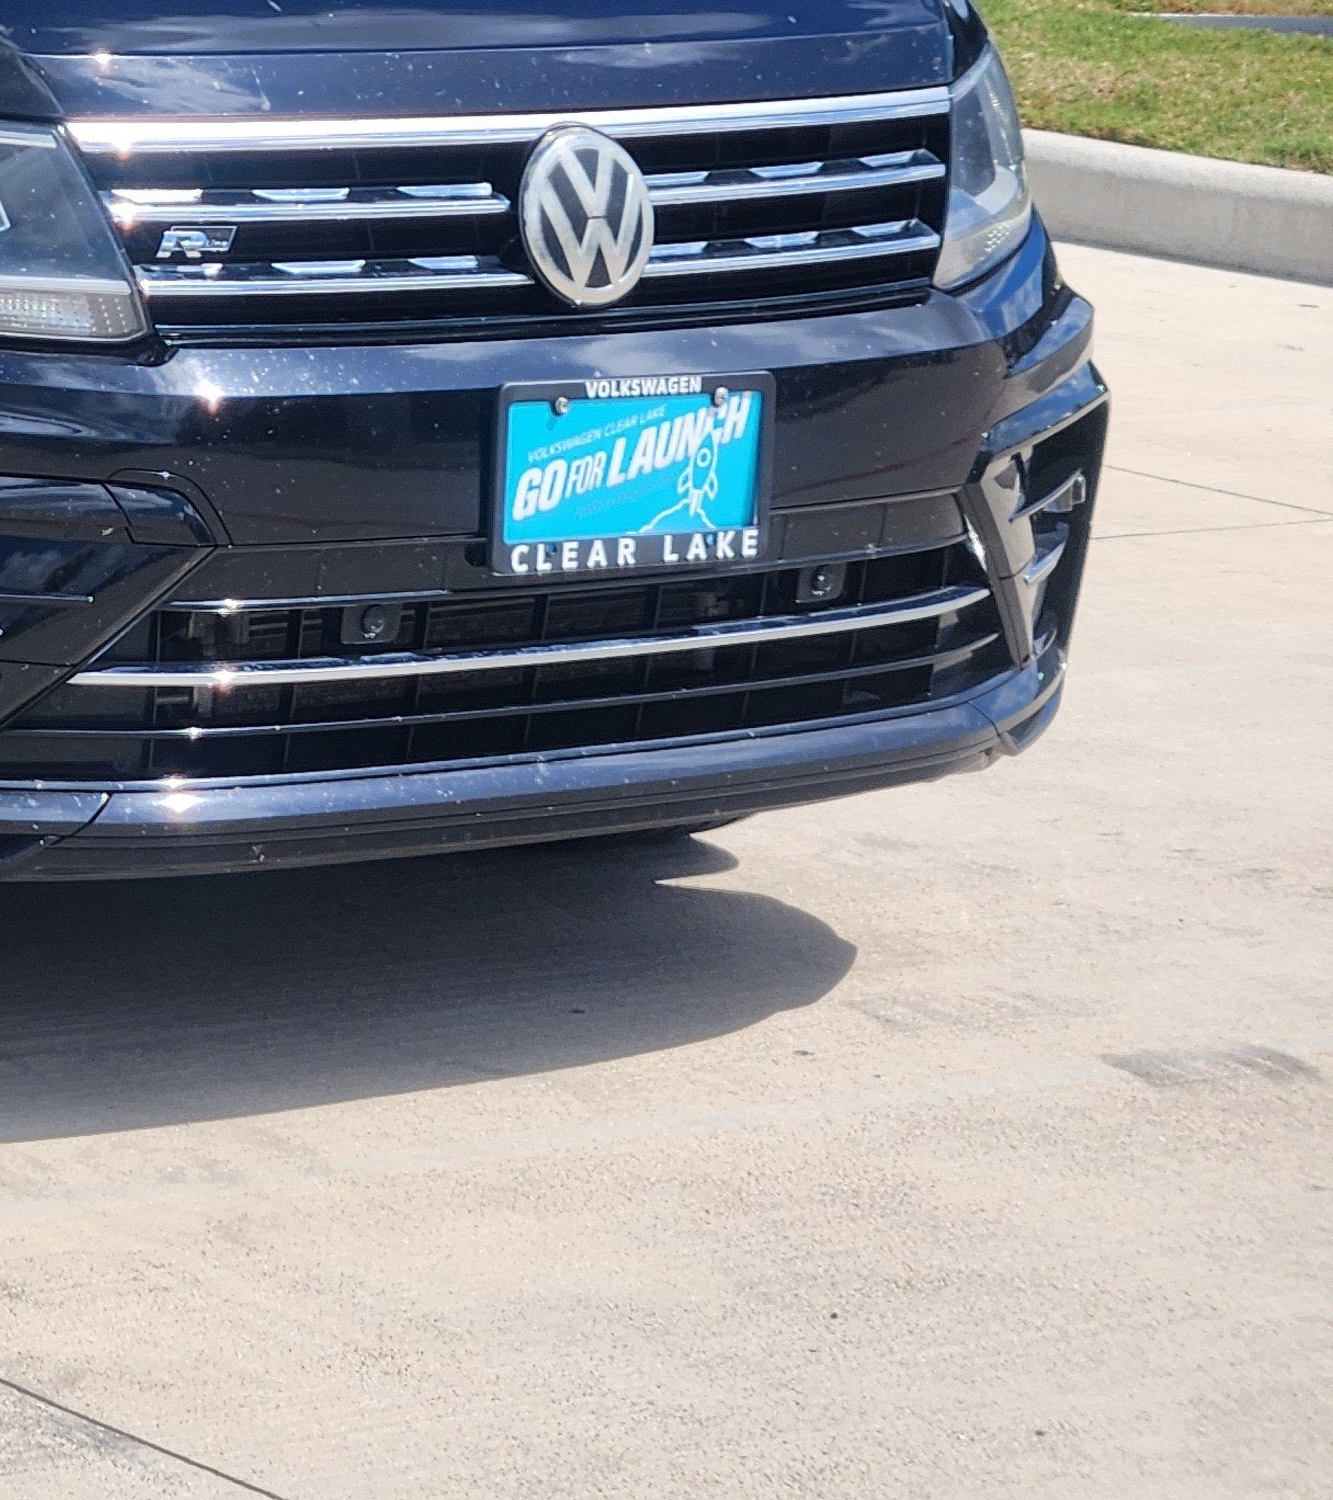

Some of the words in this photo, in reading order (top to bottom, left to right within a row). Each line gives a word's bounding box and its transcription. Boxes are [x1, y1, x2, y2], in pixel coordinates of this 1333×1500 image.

[585, 376, 702, 399] VOLKSWAGEN
[512, 458, 568, 522] GO
[565, 451, 607, 499] FOR
[606, 391, 752, 487] LAUNCH
[527, 427, 603, 464] VOLKSWAGEN
[604, 413, 639, 438] CLEAR
[639, 403, 668, 425] LAKE
[510, 537, 637, 574] CLEAR
[663, 529, 760, 561] LAKE
